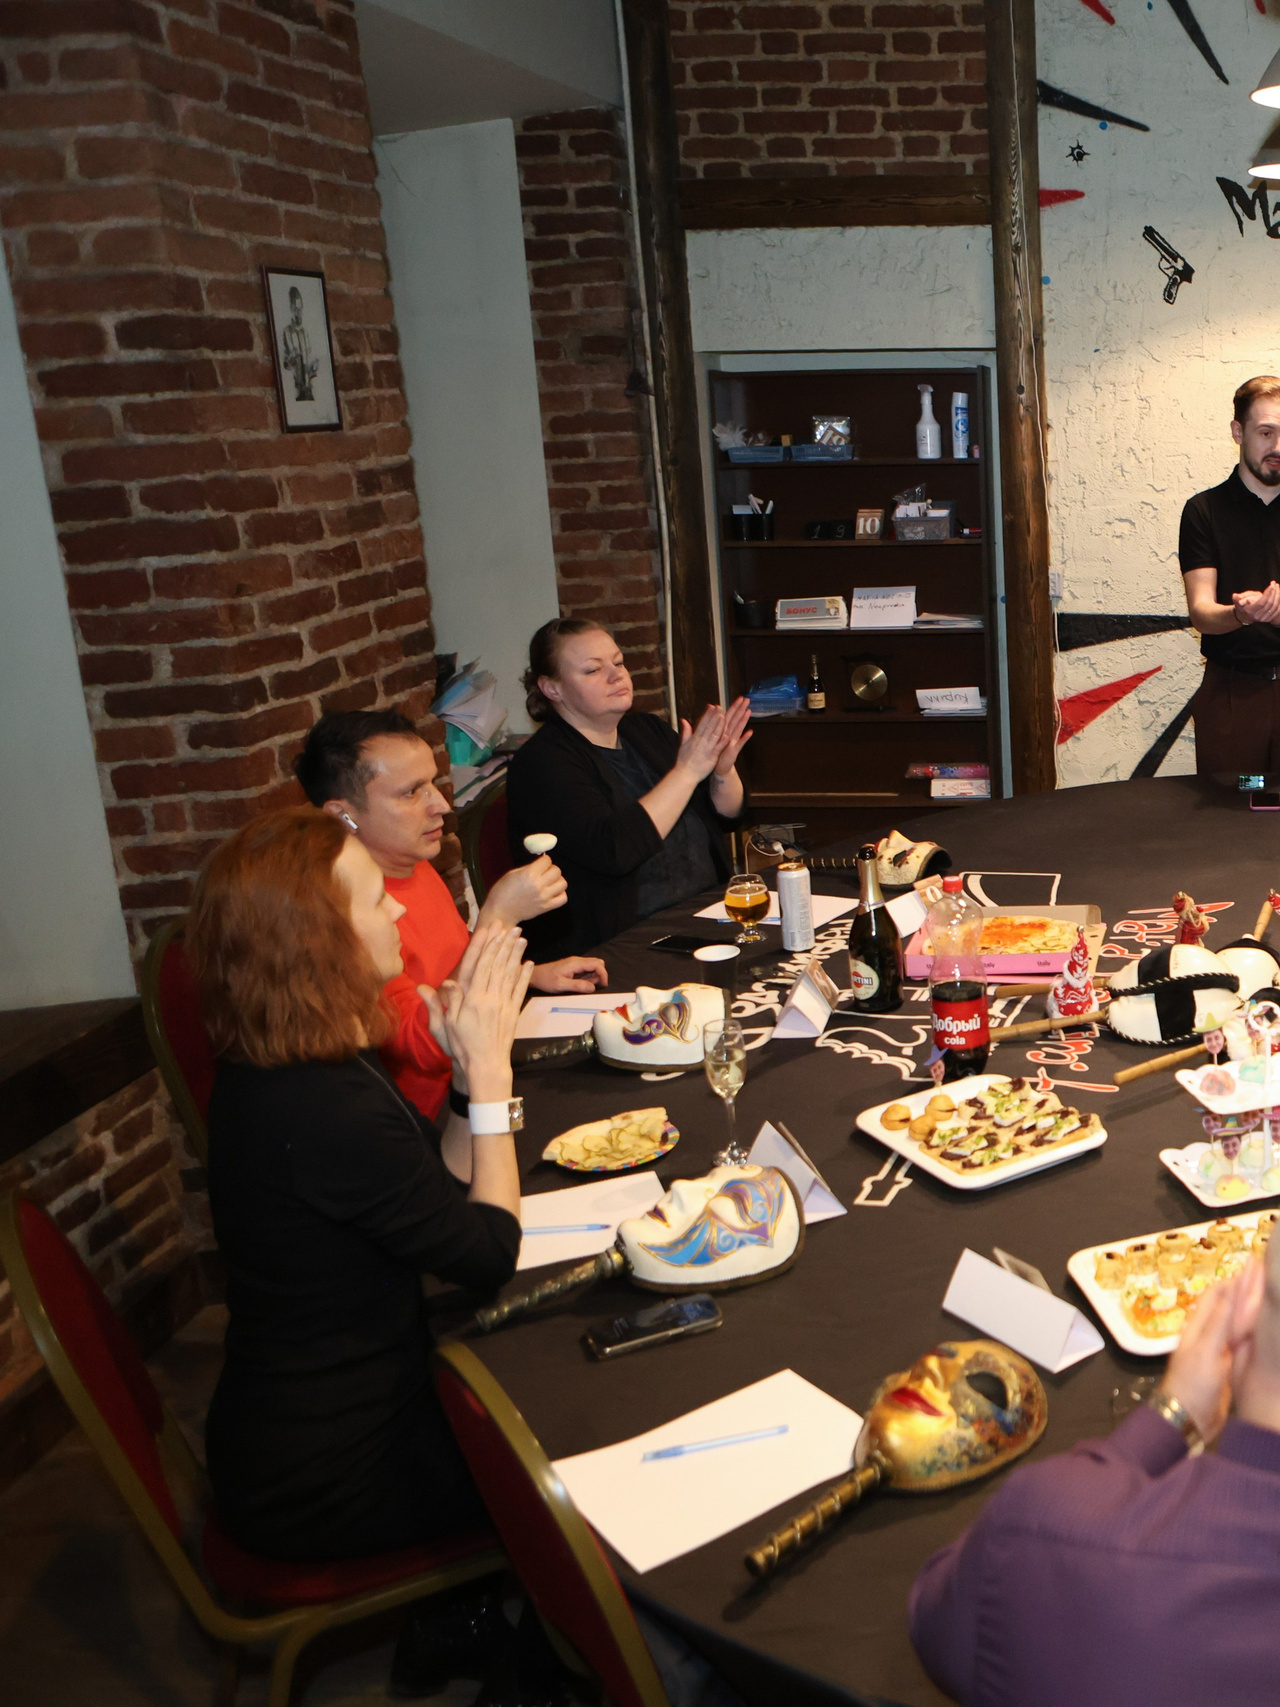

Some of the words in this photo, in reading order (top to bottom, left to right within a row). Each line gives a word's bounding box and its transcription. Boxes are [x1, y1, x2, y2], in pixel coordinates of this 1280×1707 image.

[857, 517, 881, 535] 10
[785, 606, 818, 615] БОНУС
[944, 1036, 966, 1045] cola
